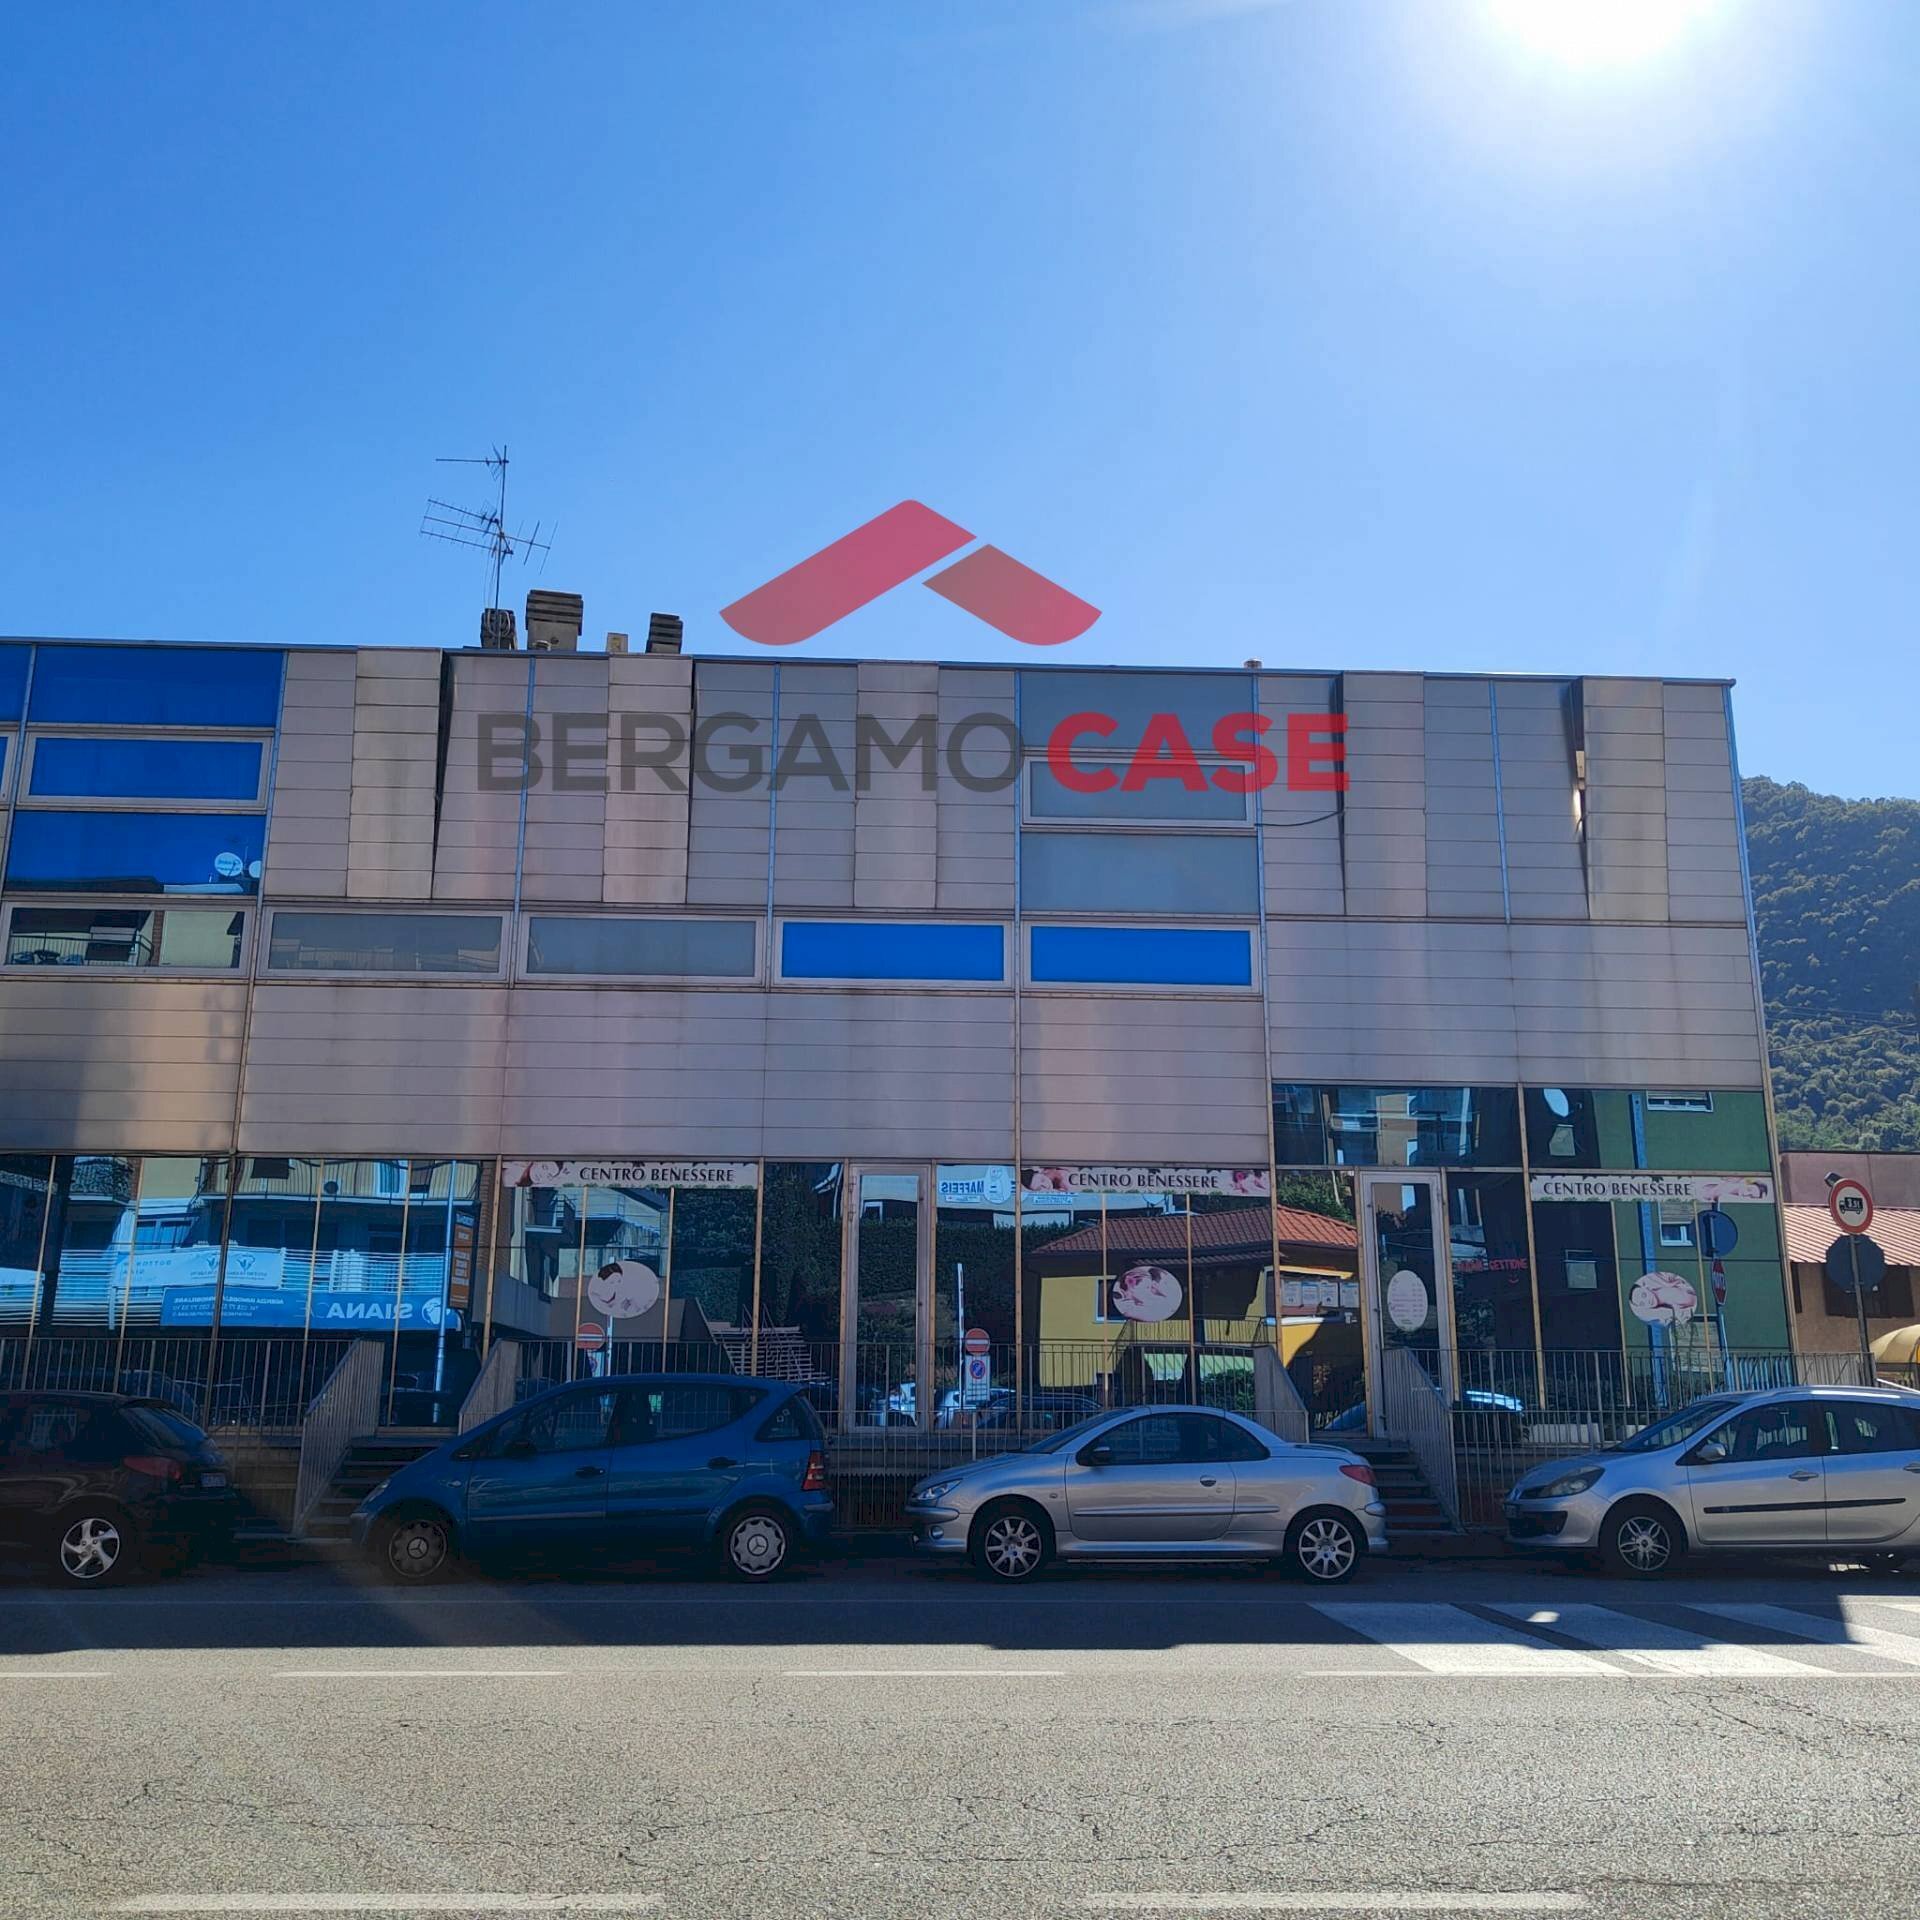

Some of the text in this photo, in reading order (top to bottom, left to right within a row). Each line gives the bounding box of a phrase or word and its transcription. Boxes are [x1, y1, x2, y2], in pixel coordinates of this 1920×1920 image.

[579, 1166, 735, 1182] CENTRO BENESSERE
[1068, 1173, 1219, 1189] CENTRO BENESSERE
[1543, 1182, 1691, 1196] CENTRO BENESSERE
